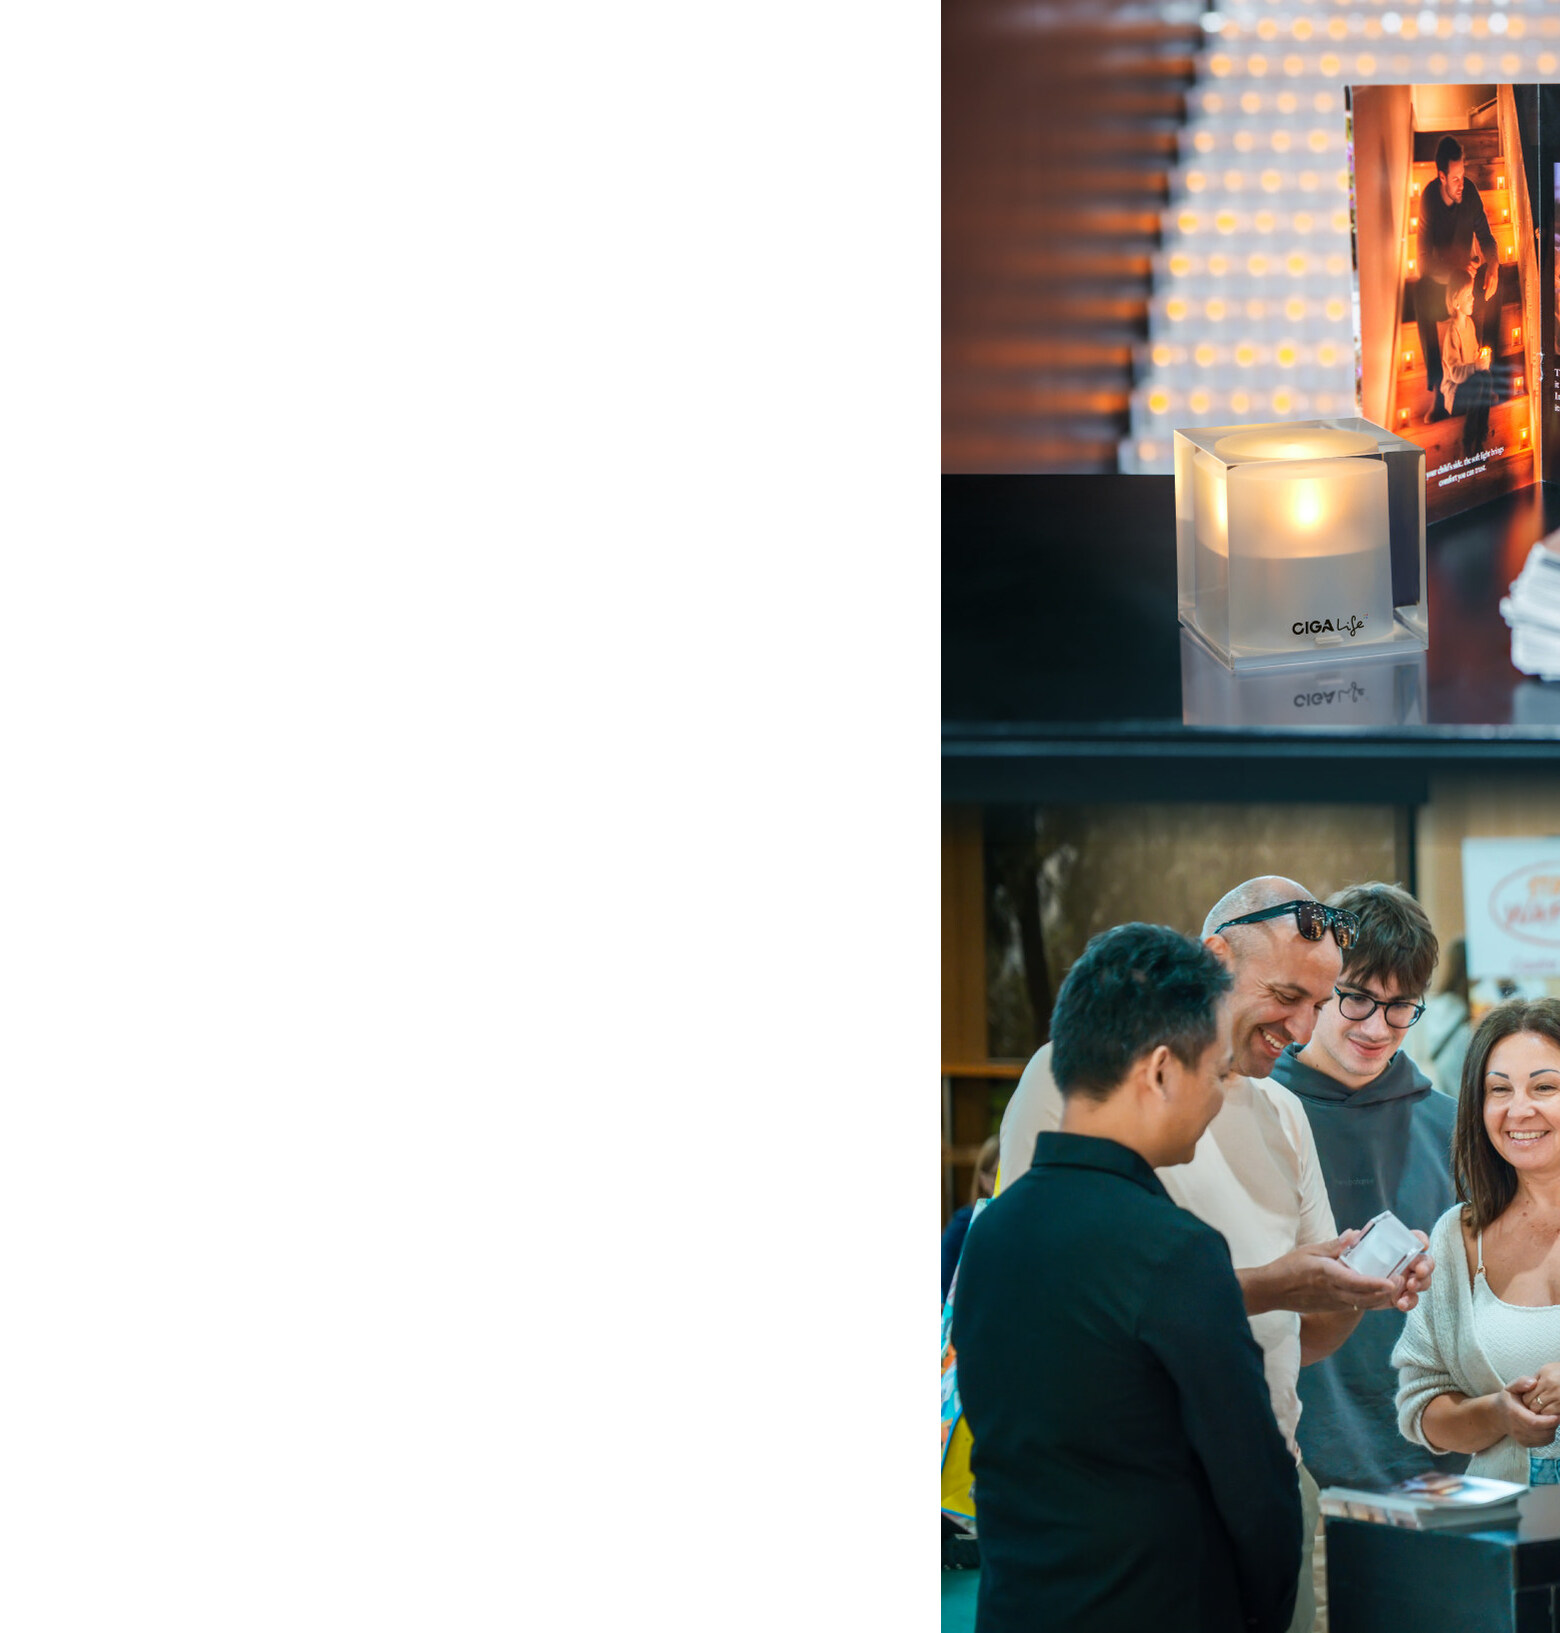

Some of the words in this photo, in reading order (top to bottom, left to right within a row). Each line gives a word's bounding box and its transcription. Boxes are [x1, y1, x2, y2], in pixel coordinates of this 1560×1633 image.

[1554, 380, 1560, 389] it
[1554, 391, 1560, 401] In
[1481, 451, 1491, 461] light
[1491, 447, 1504, 455] brings
[1439, 475, 1457, 487] comfort
[1292, 619, 1335, 635] CIGA
[1336, 615, 1365, 637] Life
